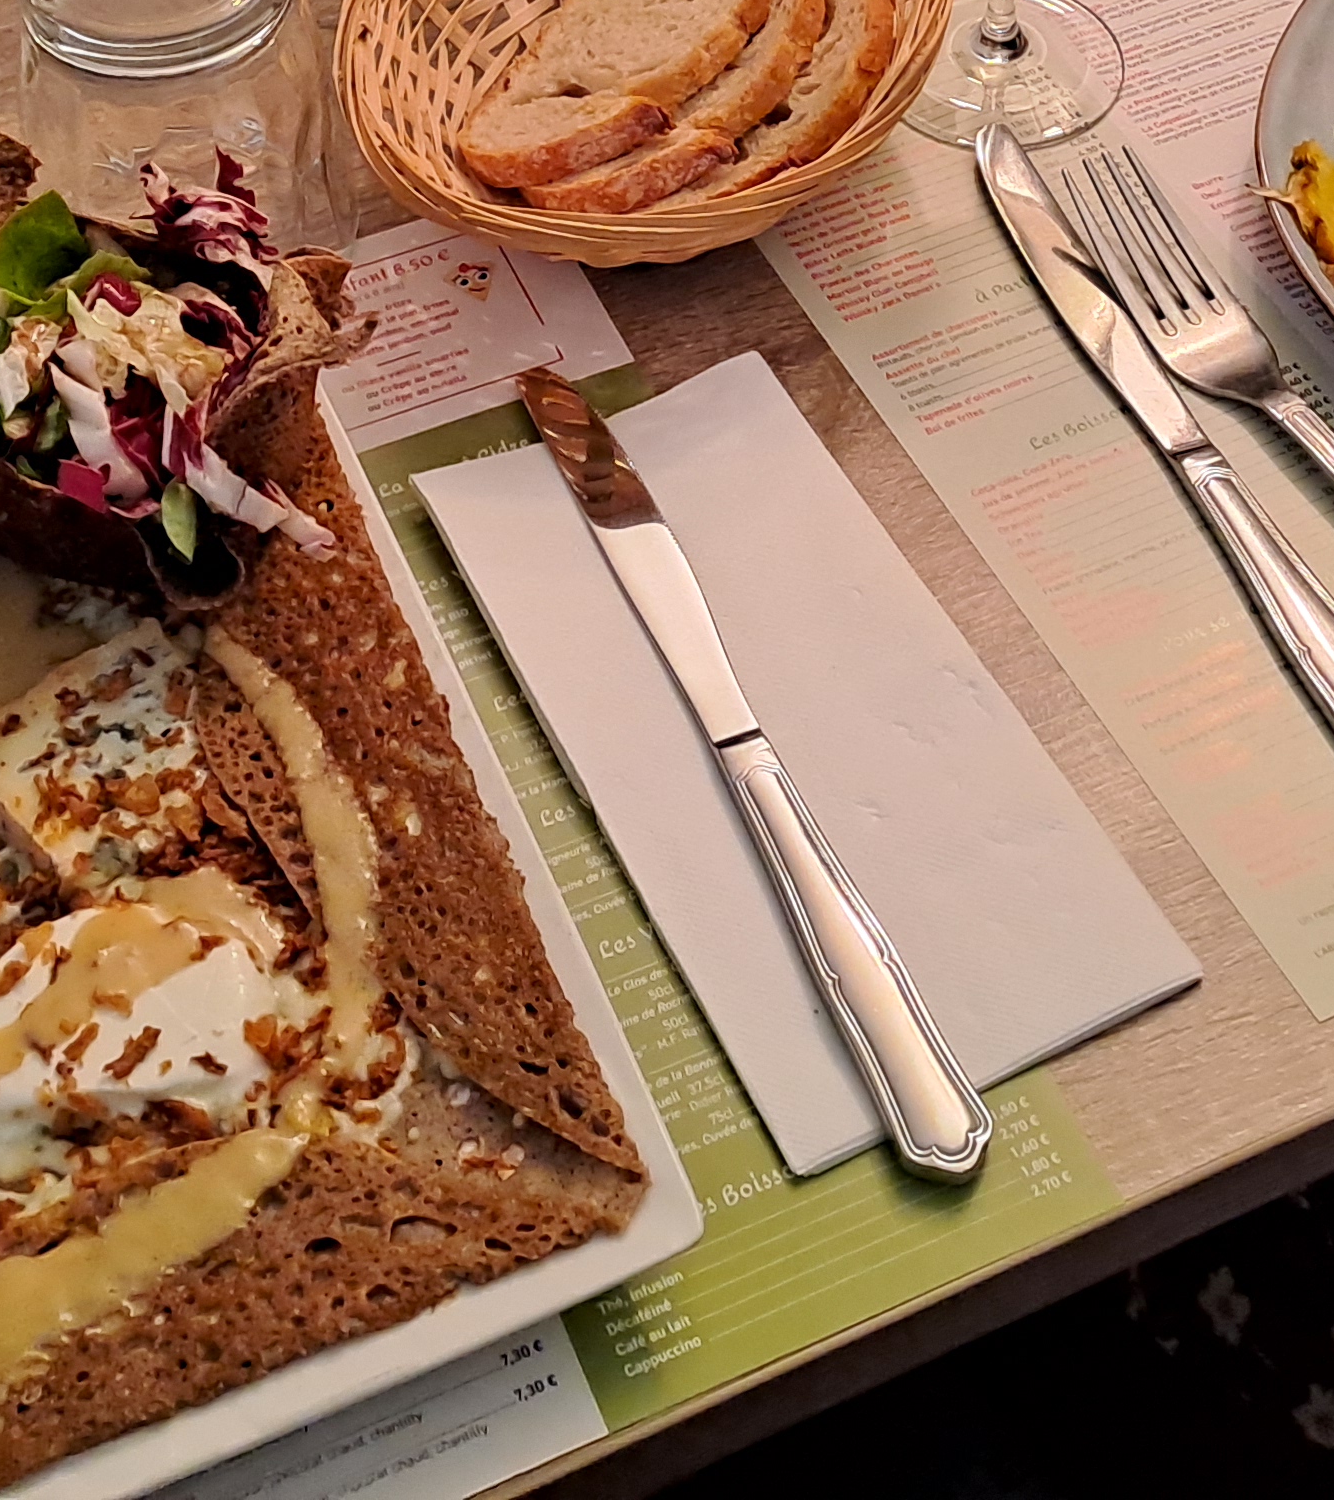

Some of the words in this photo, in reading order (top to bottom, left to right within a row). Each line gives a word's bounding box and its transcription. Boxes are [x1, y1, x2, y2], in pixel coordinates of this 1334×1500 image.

[341, 267, 388, 294] nfant
[1028, 431, 1061, 451] Les
[1062, 403, 1118, 437] Boisso
[539, 800, 576, 827] Les
[598, 935, 637, 959] Les
[622, 975, 649, 991] Clos
[647, 981, 676, 1001] 50cl
[640, 1008, 656, 1021] de
[662, 1012, 690, 1031] 50cl
[655, 1076, 670, 1089] de
[707, 1106, 735, 1126] 75cl
[701, 1124, 739, 1146] Cuvée
[721, 1158, 801, 1207] Boisso
[1030, 1175, 1062, 1198] 2,70
[626, 1271, 684, 1302] infusion
[605, 1298, 672, 1337] Décaféiné
[614, 1333, 648, 1357] Café
[648, 1327, 668, 1343] au
[666, 1315, 692, 1334] lait
[499, 1345, 532, 1367] 7,30
[622, 1336, 703, 1378] Cappuccino
[513, 1379, 546, 1402] 7,30
[367, 1411, 424, 1441] chantilly
[436, 1424, 489, 1455] chantilly
